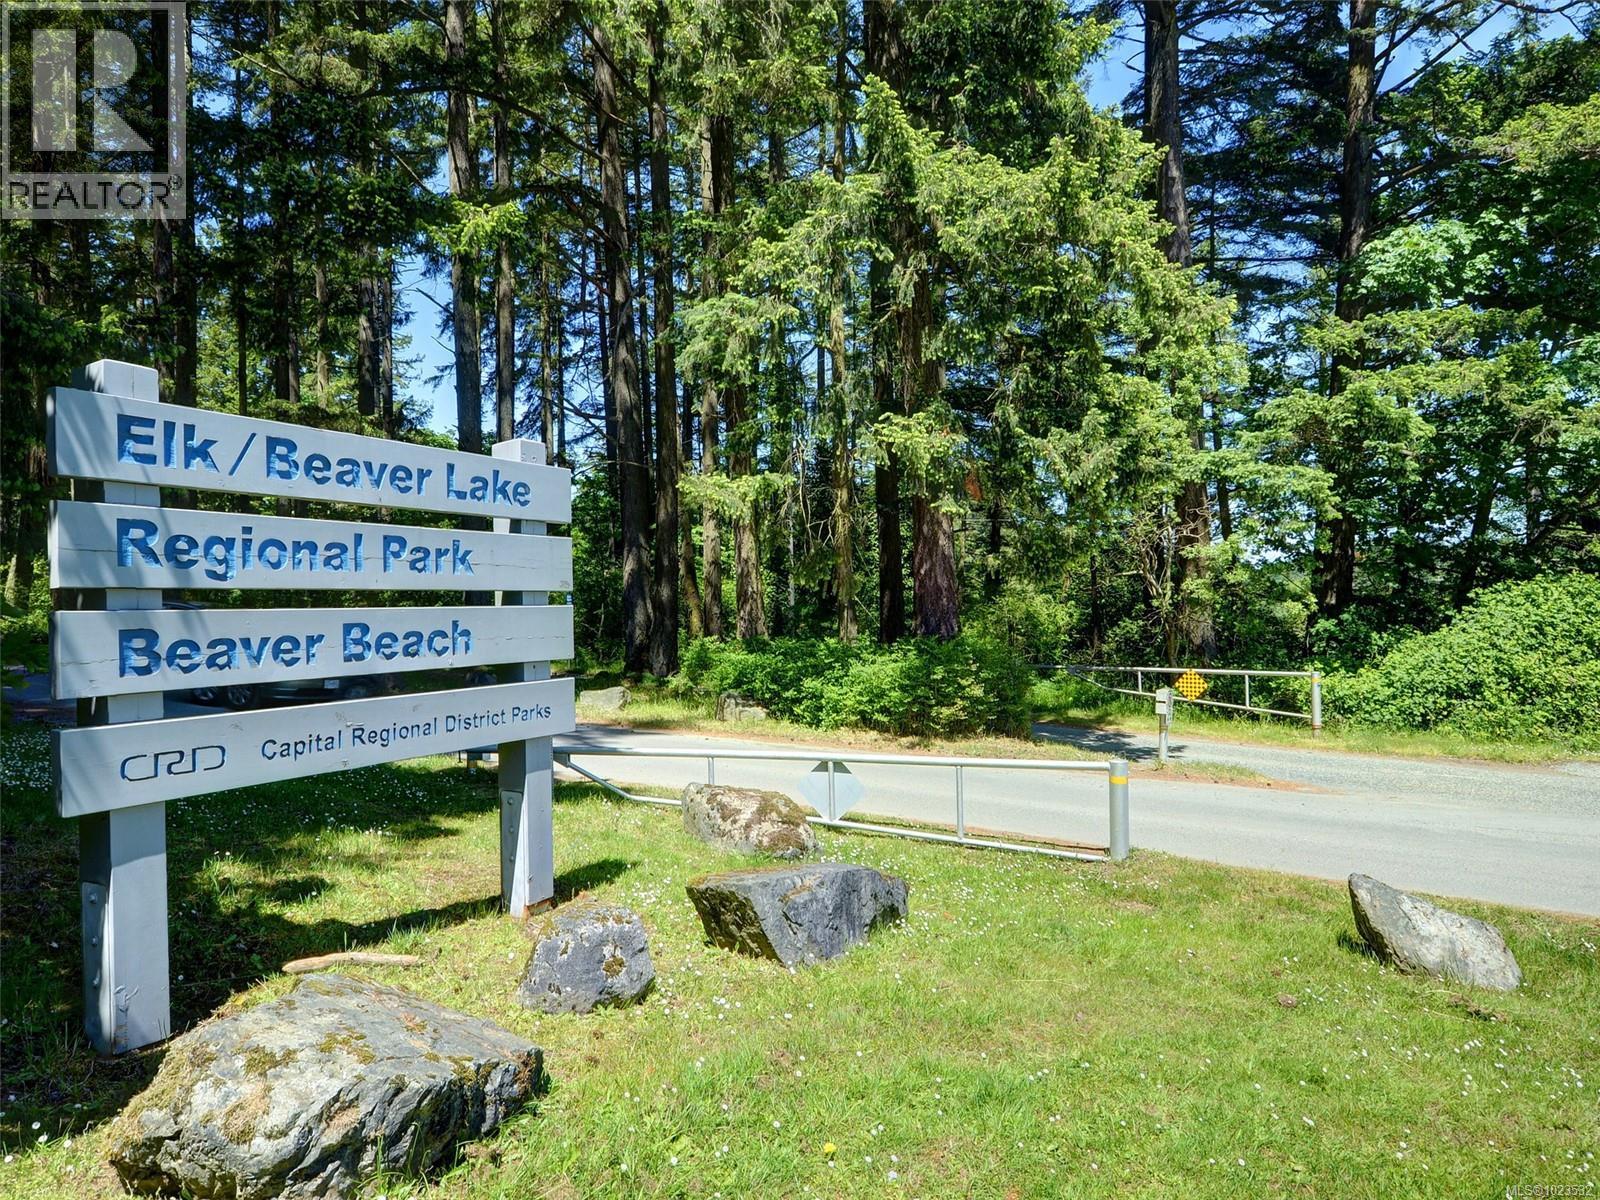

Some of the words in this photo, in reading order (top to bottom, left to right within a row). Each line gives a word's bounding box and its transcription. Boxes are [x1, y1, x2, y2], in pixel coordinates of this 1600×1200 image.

[446, 462, 532, 508] Lake
[116, 517, 365, 582] Regional
[382, 534, 475, 577] Park
[118, 628, 325, 678] Beaver
[342, 619, 473, 664] Beach
[261, 730, 343, 764] Capital
[351, 716, 439, 750] Regional
[445, 708, 507, 733] District
[511, 703, 552, 722] Parks
